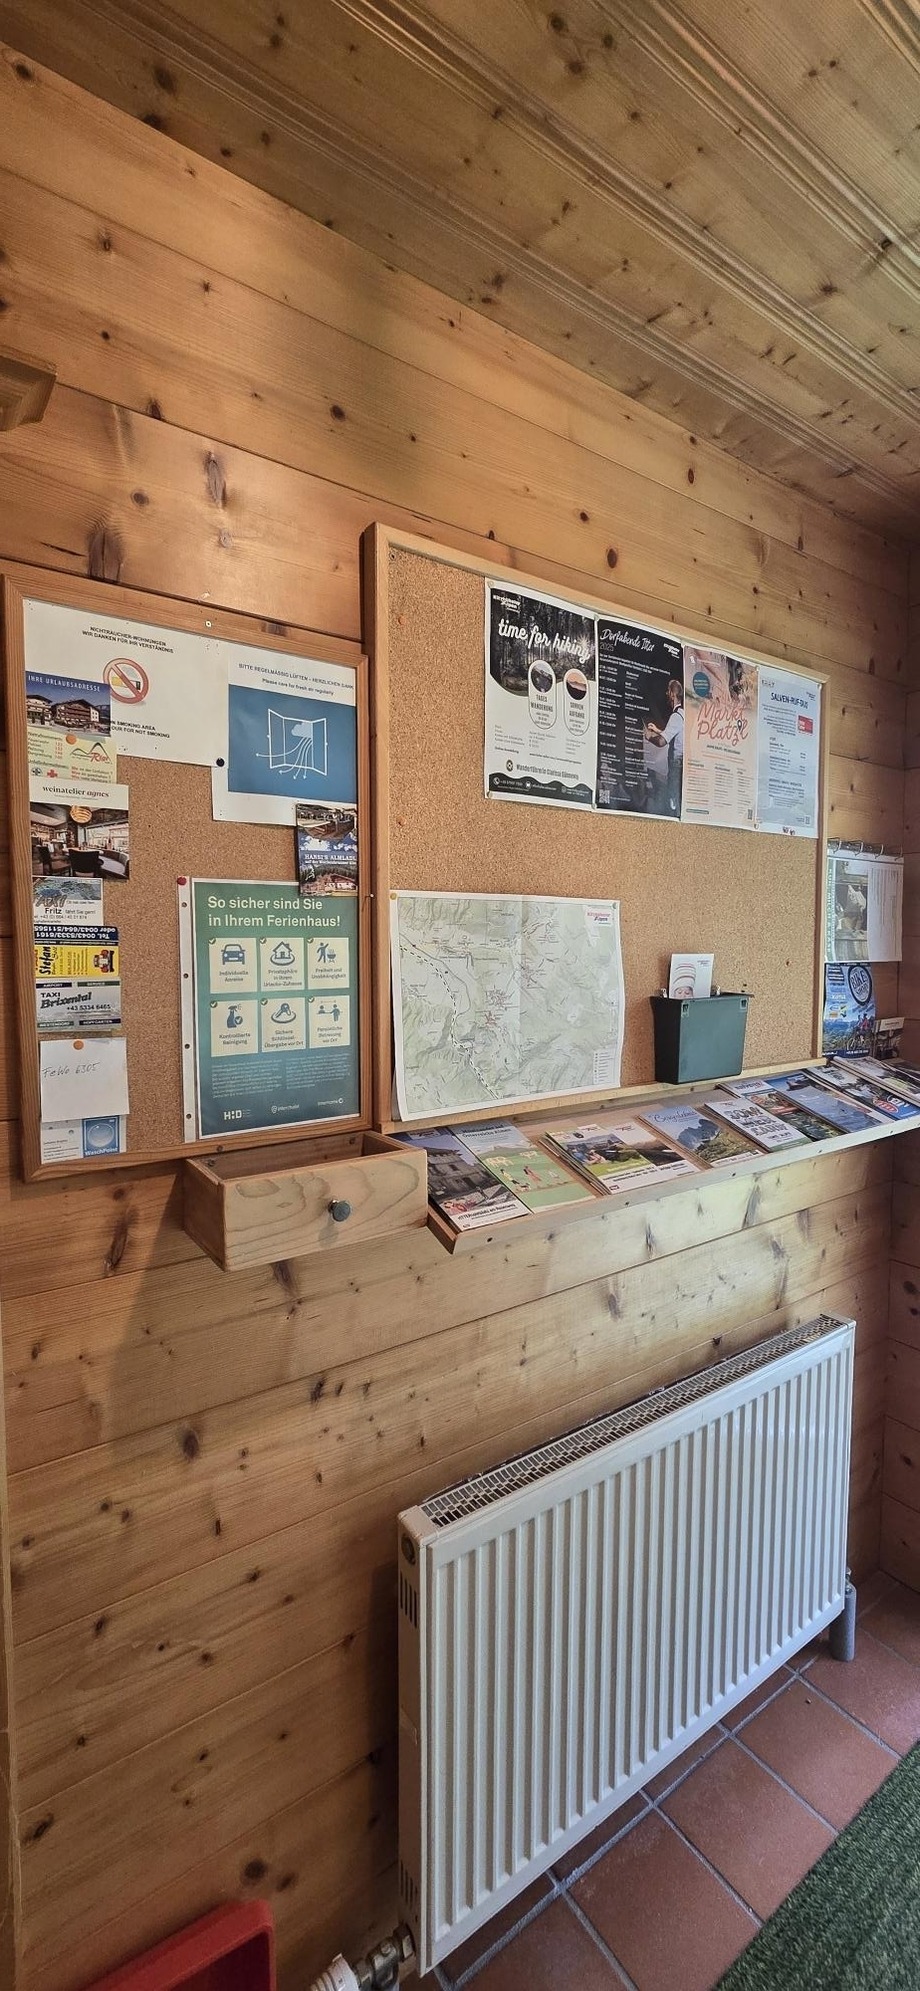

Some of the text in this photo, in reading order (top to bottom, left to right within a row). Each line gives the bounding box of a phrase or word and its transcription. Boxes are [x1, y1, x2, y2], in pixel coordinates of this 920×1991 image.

[94, 632, 116, 641] DANKEN
[117, 636, 128, 644] FÜR
[139, 641, 174, 654] VERSTÄNDNIS
[499, 618, 528, 640] time
[528, 625, 551, 649] for
[552, 633, 590, 664] hiking
[600, 628, 640, 648] Dorfabende
[28, 675, 100, 692] IHRE URLAUBSADRESSE
[290, 673, 308, 681] LÜFTEN
[312, 677, 341, 686] HERZLICHEN
[315, 688, 334, 696] regularly
[117, 721, 141, 729] SMOKING
[147, 731, 170, 739] SMOKING
[42, 785, 85, 796] weinatelier
[87, 790, 109, 798] agnes
[208, 896, 323, 910] So sicher sind Sie
[44, 907, 62, 915] Fritz
[208, 914, 341, 927] in Ihrem Ferienhaus!
[39, 946, 54, 975] Stefan
[40, 991, 92, 1009] Brixental
